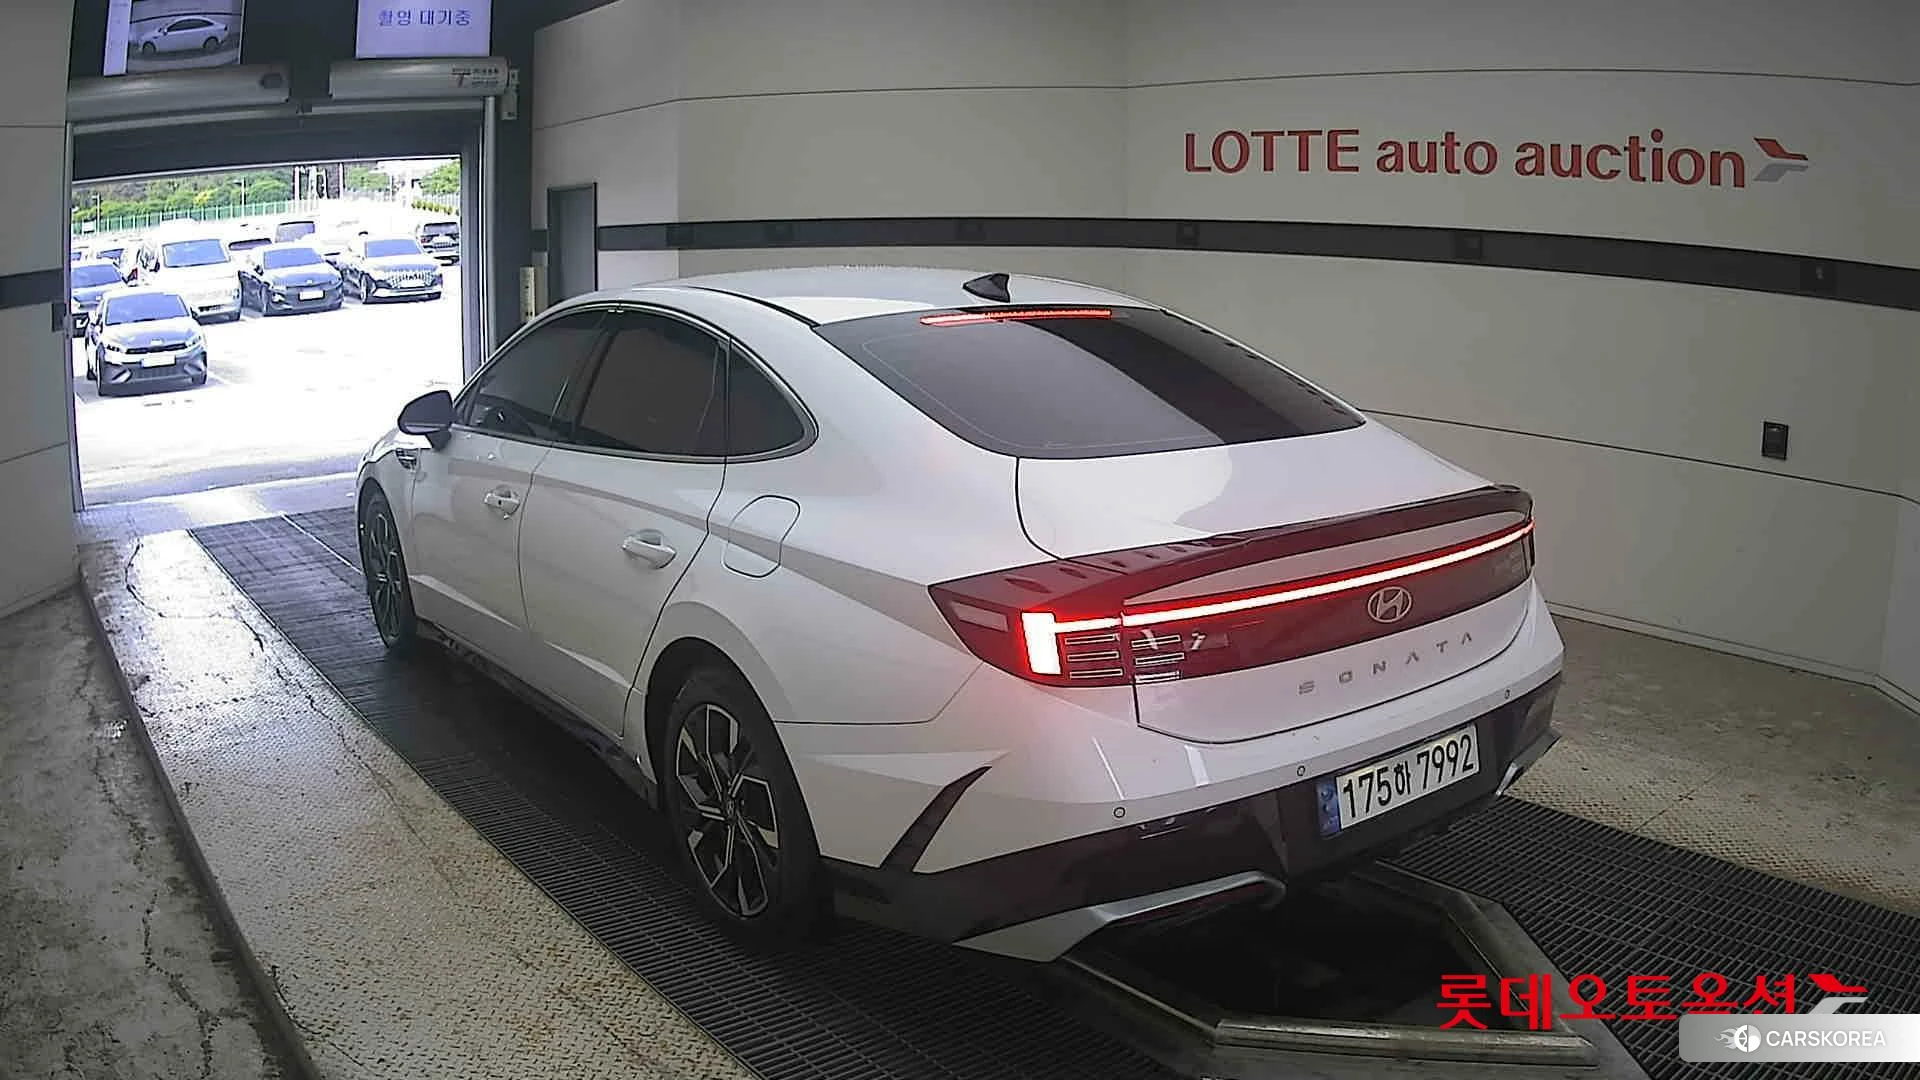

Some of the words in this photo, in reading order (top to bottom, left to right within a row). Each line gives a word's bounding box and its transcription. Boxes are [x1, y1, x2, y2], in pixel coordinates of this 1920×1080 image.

[419, 9, 472, 27] 대기중
[1184, 129, 1360, 174] LOTTE
[1376, 131, 1498, 176] auto
[1514, 128, 1746, 189] auction
[1298, 632, 1473, 696] SONATA
[1416, 734, 1474, 790] 7992
